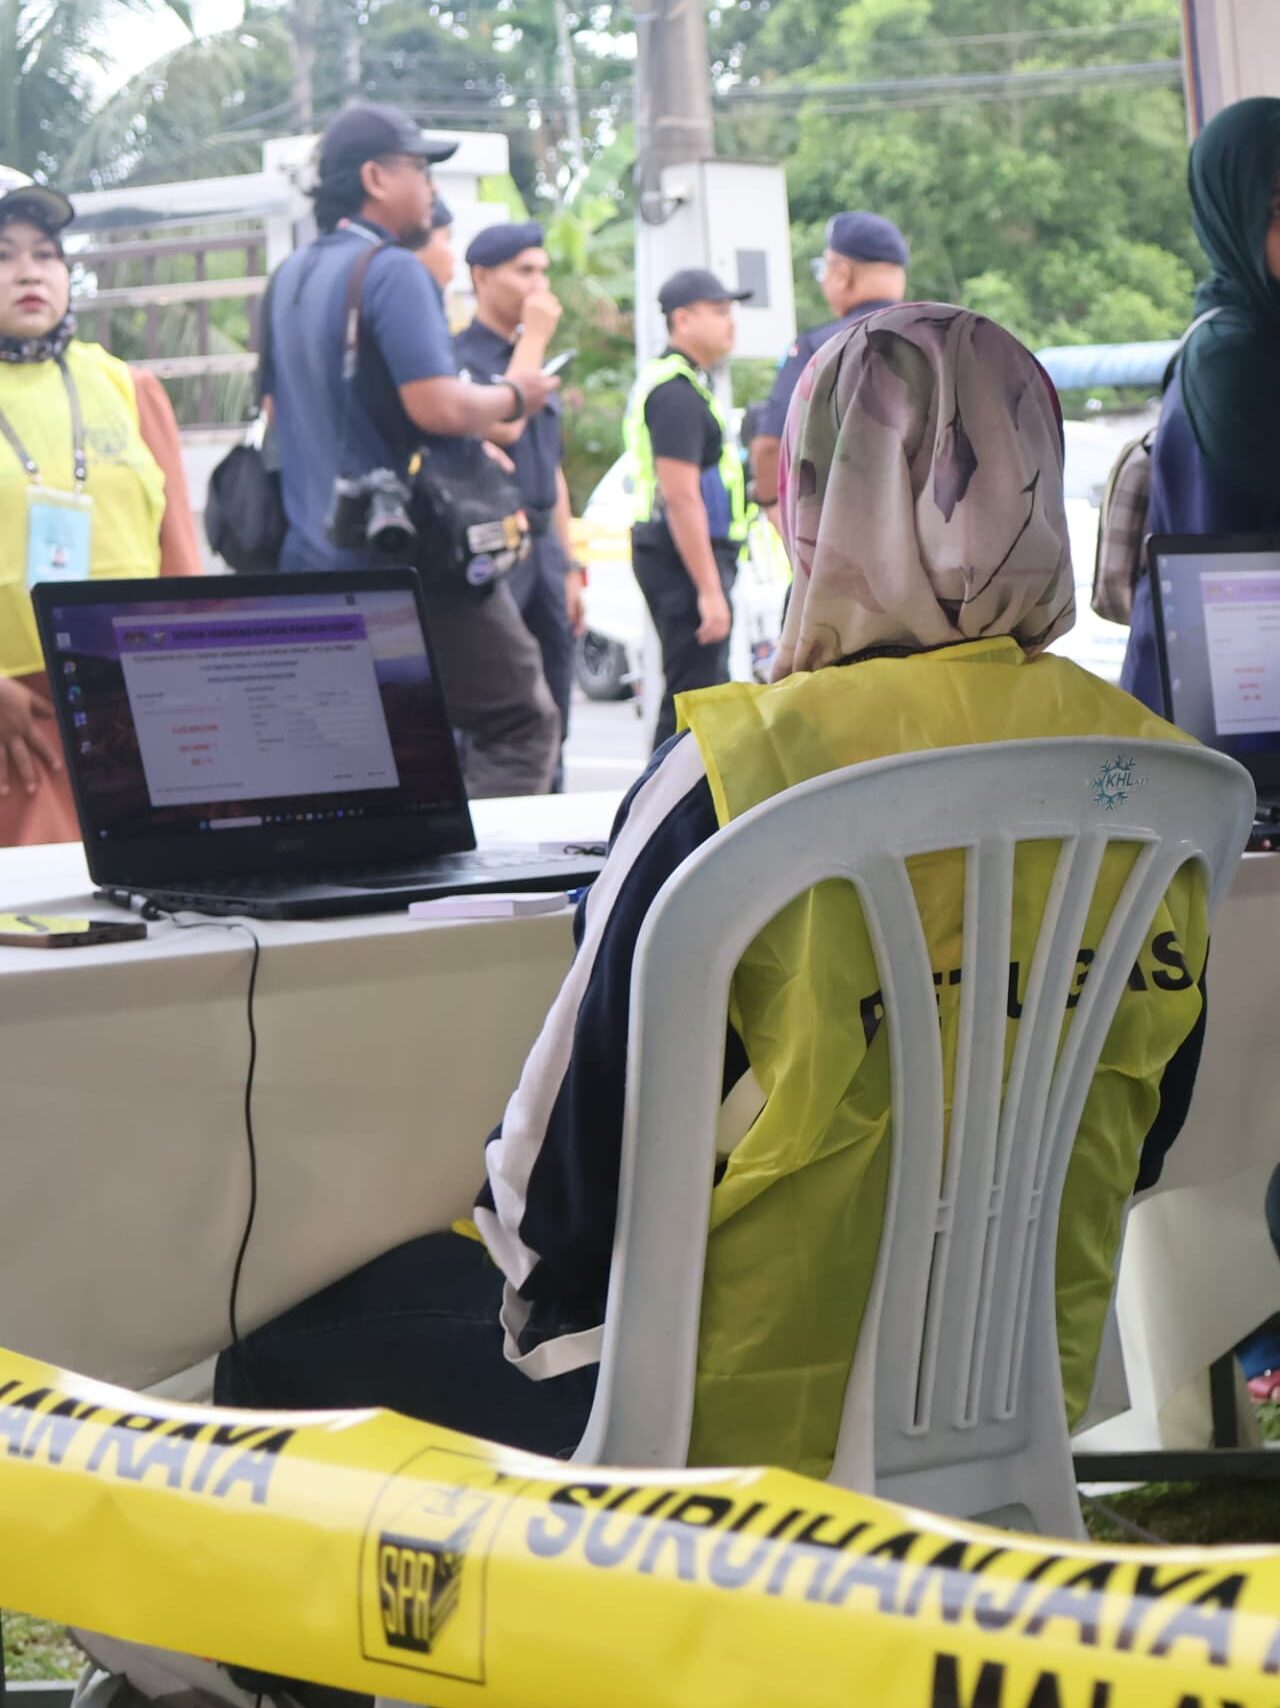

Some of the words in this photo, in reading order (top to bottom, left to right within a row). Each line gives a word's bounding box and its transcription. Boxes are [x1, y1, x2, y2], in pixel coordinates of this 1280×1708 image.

[1106, 772, 1133, 787] KHL
[86, 1414, 297, 1505] RAYA
[382, 1545, 436, 1640] SPR
[526, 1483, 1249, 1667] SURUHANJAYA
